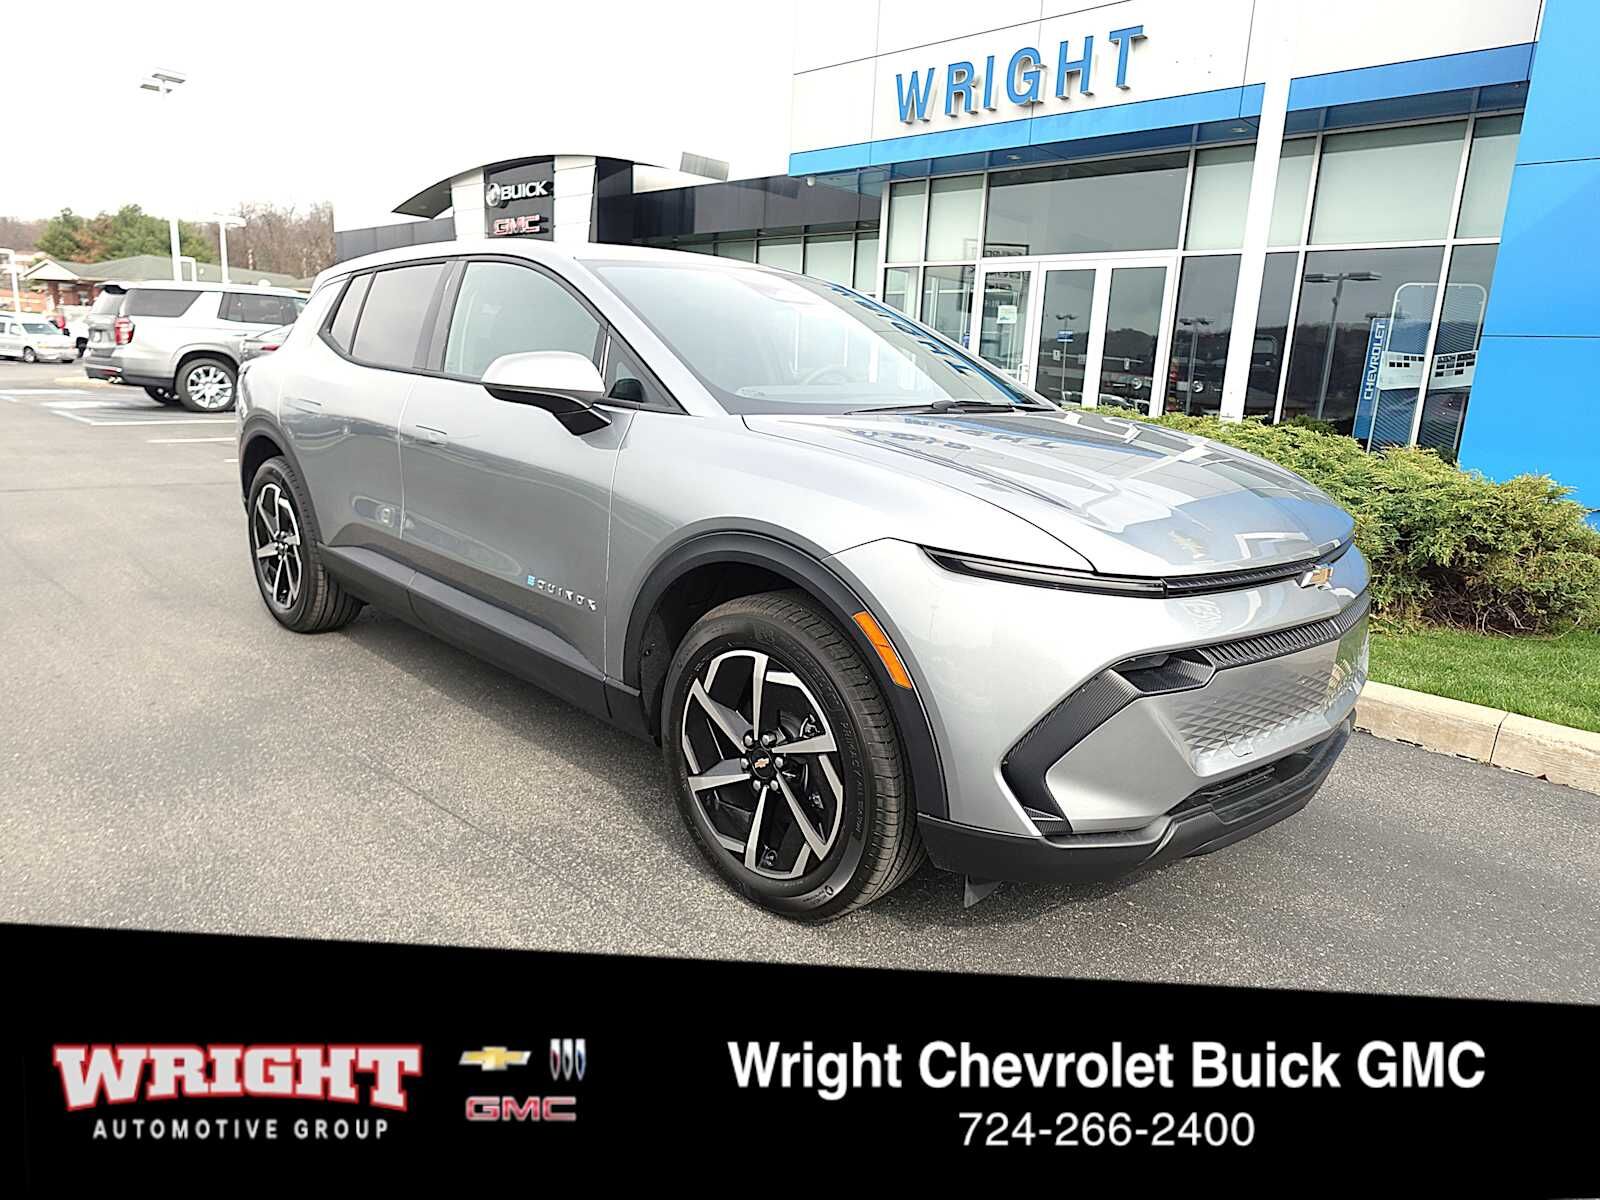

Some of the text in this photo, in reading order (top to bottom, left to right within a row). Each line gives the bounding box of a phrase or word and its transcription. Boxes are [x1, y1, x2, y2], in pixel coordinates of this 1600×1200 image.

[895, 24, 1147, 124] WRIGHT
[500, 181, 548, 201] BUICK
[494, 215, 540, 236] GMC
[1363, 322, 1386, 401] CHEVROLET
[527, 574, 598, 611] EQUINOX
